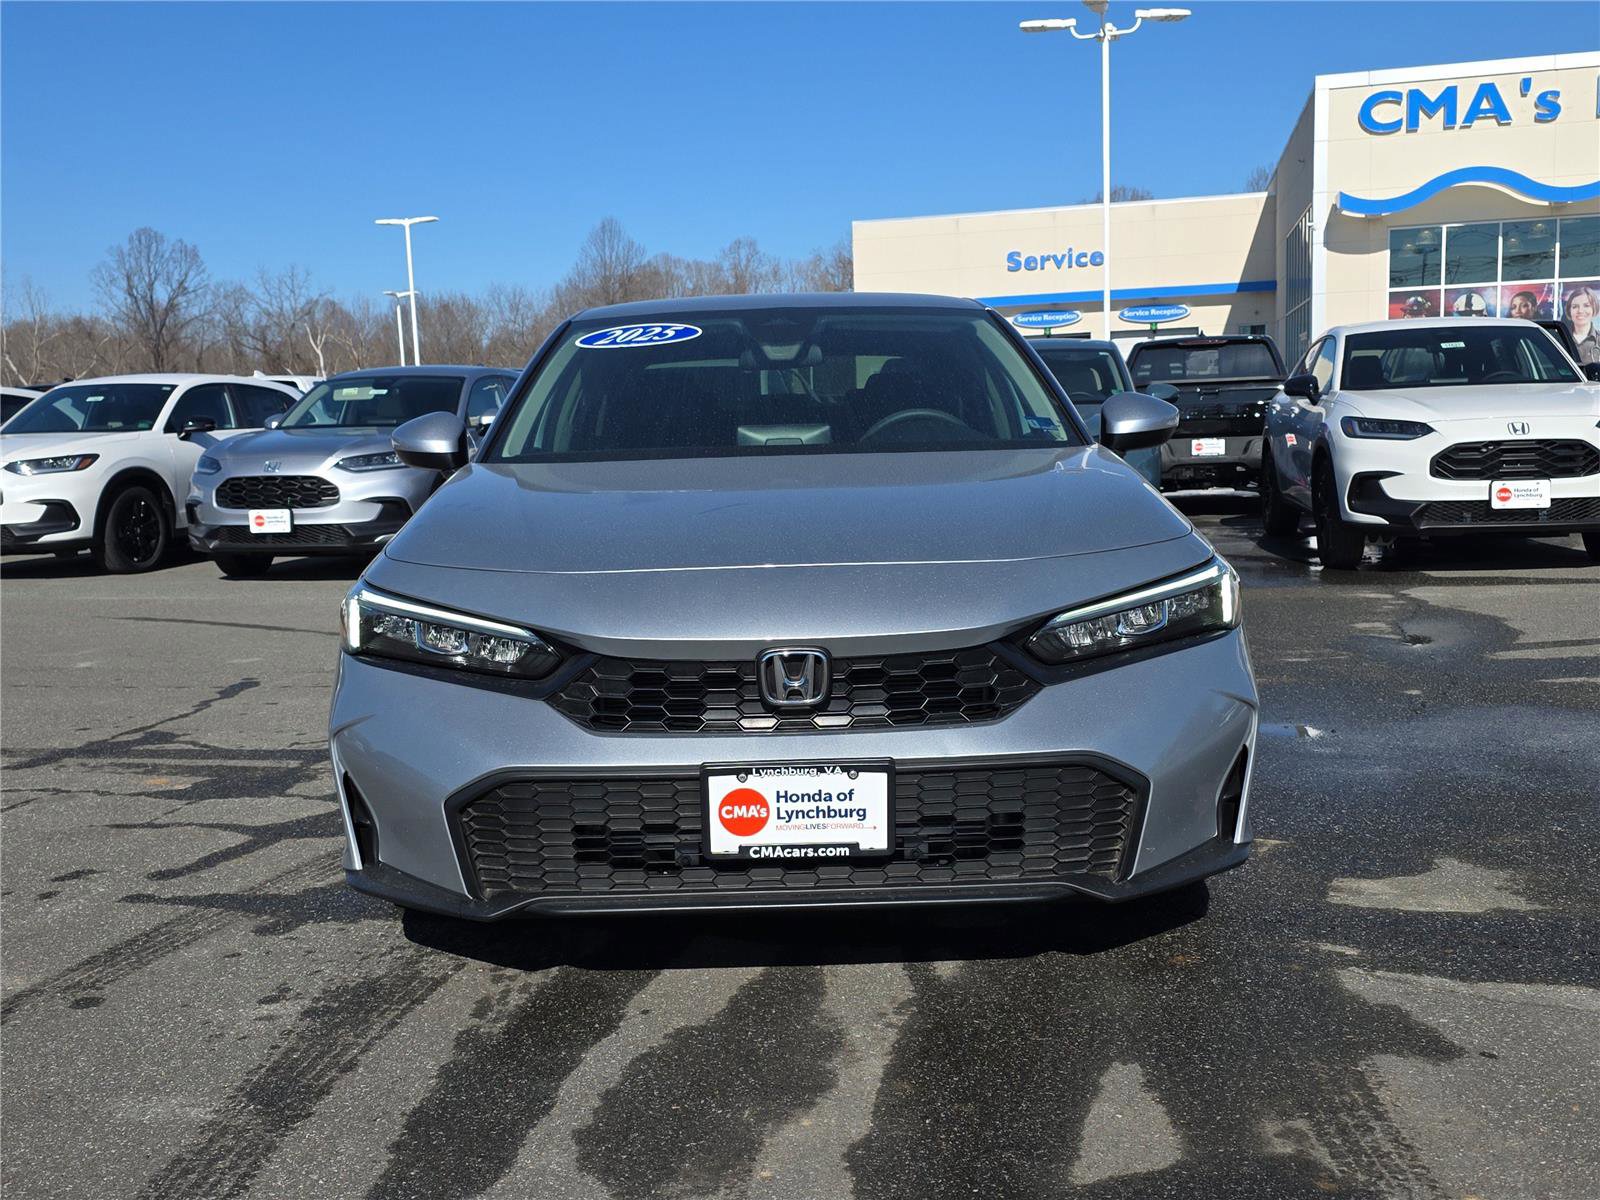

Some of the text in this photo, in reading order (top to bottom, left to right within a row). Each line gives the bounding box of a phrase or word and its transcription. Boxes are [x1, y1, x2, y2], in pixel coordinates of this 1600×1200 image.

[1358, 77, 1562, 136] CMA's
[1006, 247, 1104, 272] Service
[1017, 312, 1078, 322] Service Reception
[1150, 308, 1186, 317] Reception
[593, 327, 685, 345] 2025
[752, 766, 843, 777] Lynchburg, VA
[776, 788, 855, 803] Honda of
[721, 804, 768, 819] CMA's
[776, 805, 867, 823] Lynchburg
[749, 846, 850, 859] CMAcars.com
